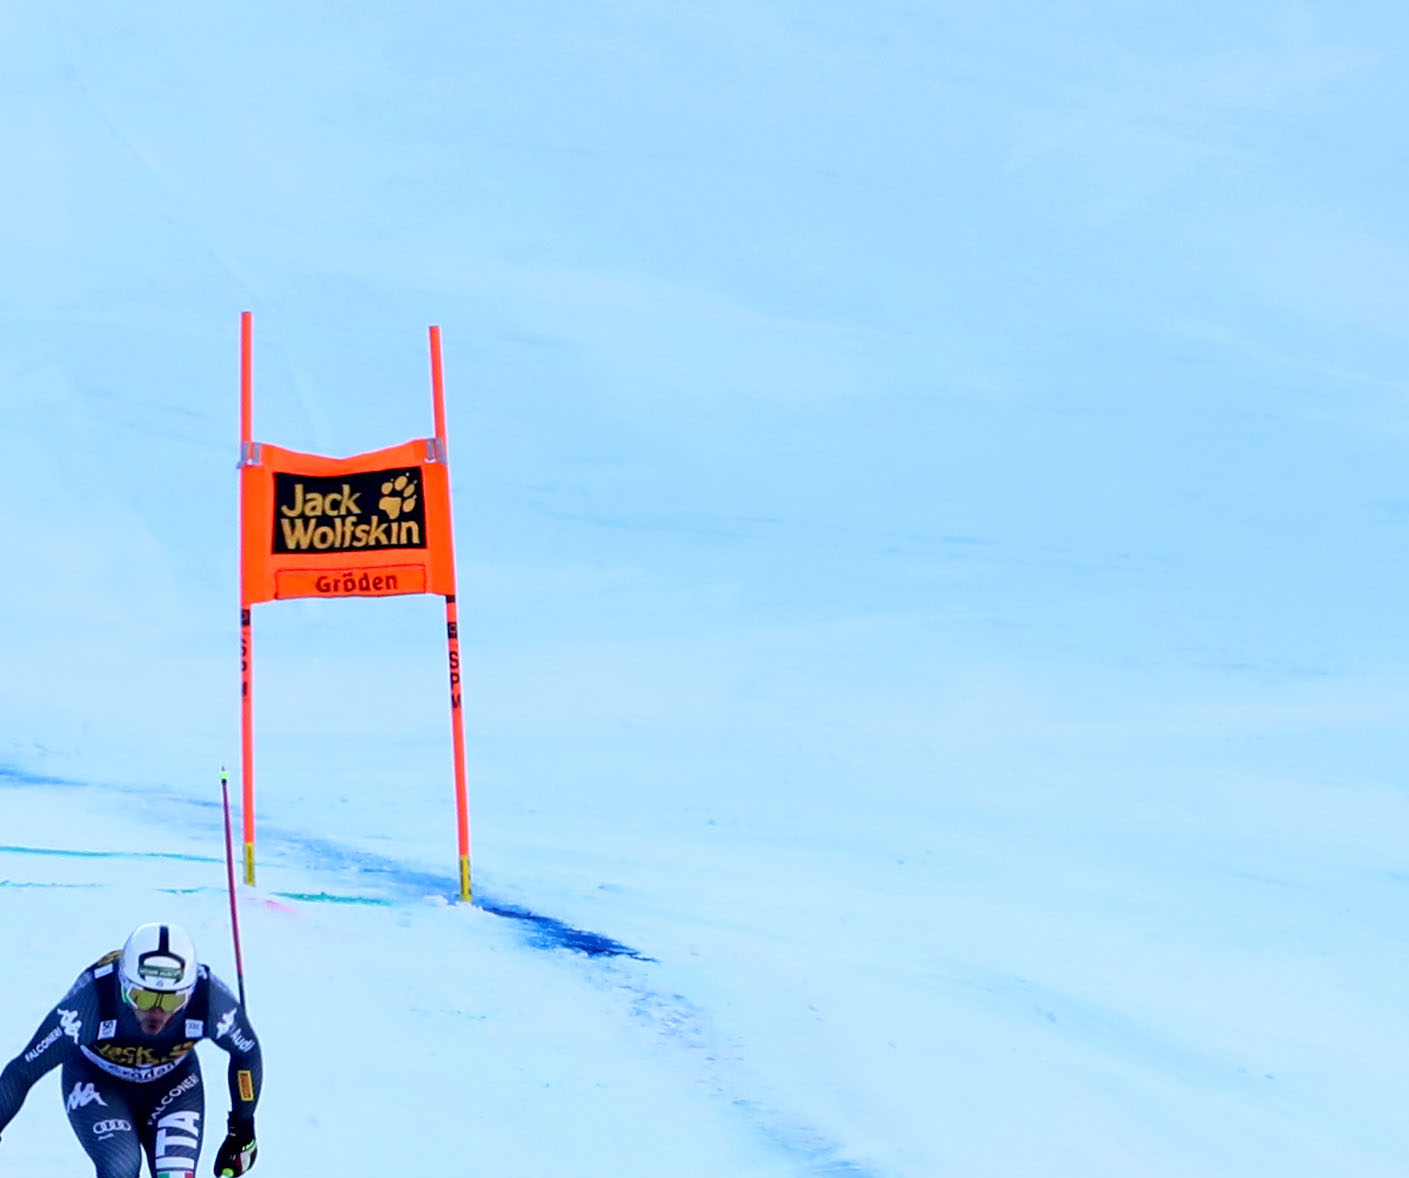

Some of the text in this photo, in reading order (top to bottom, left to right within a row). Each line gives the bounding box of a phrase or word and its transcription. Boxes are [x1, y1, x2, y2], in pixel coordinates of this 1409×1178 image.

[280, 484, 362, 517] Jack
[280, 515, 420, 550] Wolfskin
[315, 572, 398, 593] Gröden
[230, 1028, 256, 1053] Audi
[155, 1110, 200, 1170] ITA
